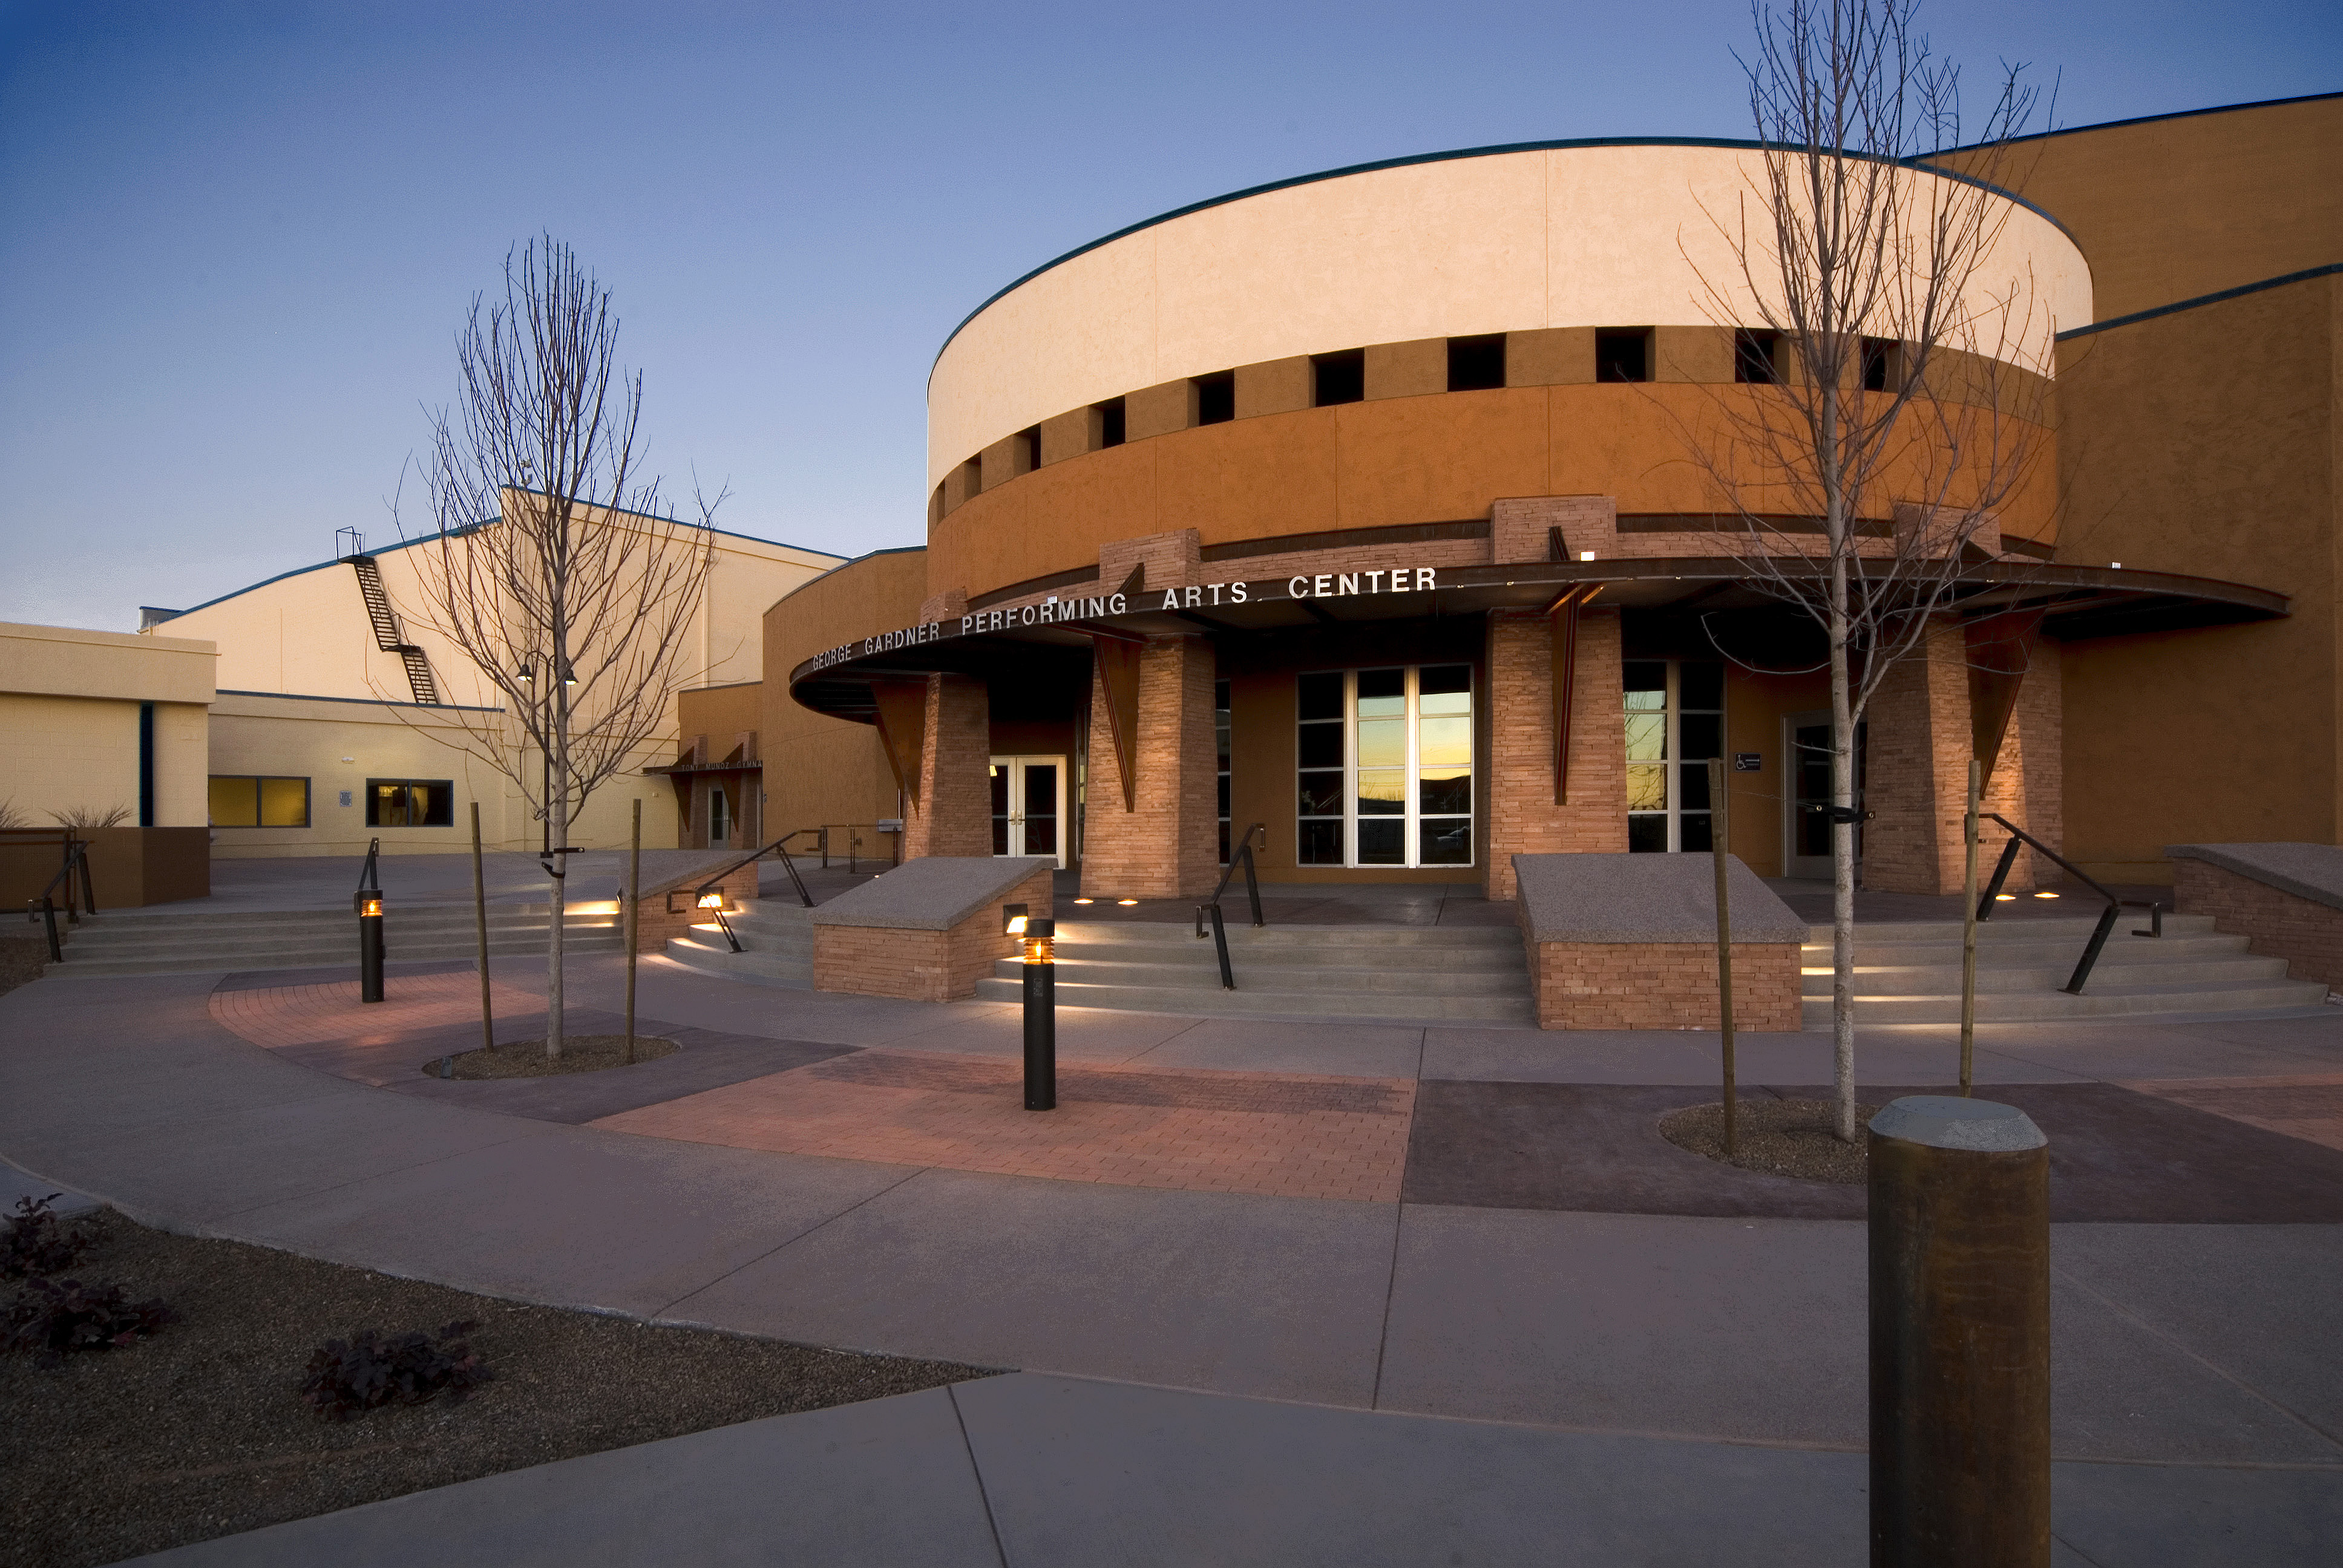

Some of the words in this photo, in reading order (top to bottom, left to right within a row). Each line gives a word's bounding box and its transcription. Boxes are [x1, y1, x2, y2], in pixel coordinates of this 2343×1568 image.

[813, 644, 852, 671] GEORGE
[865, 622, 939, 655] GARDNER
[962, 593, 1126, 635] PERFORMING
[1162, 581, 1247, 610] ARTS
[1288, 567, 1436, 599] CENTER
